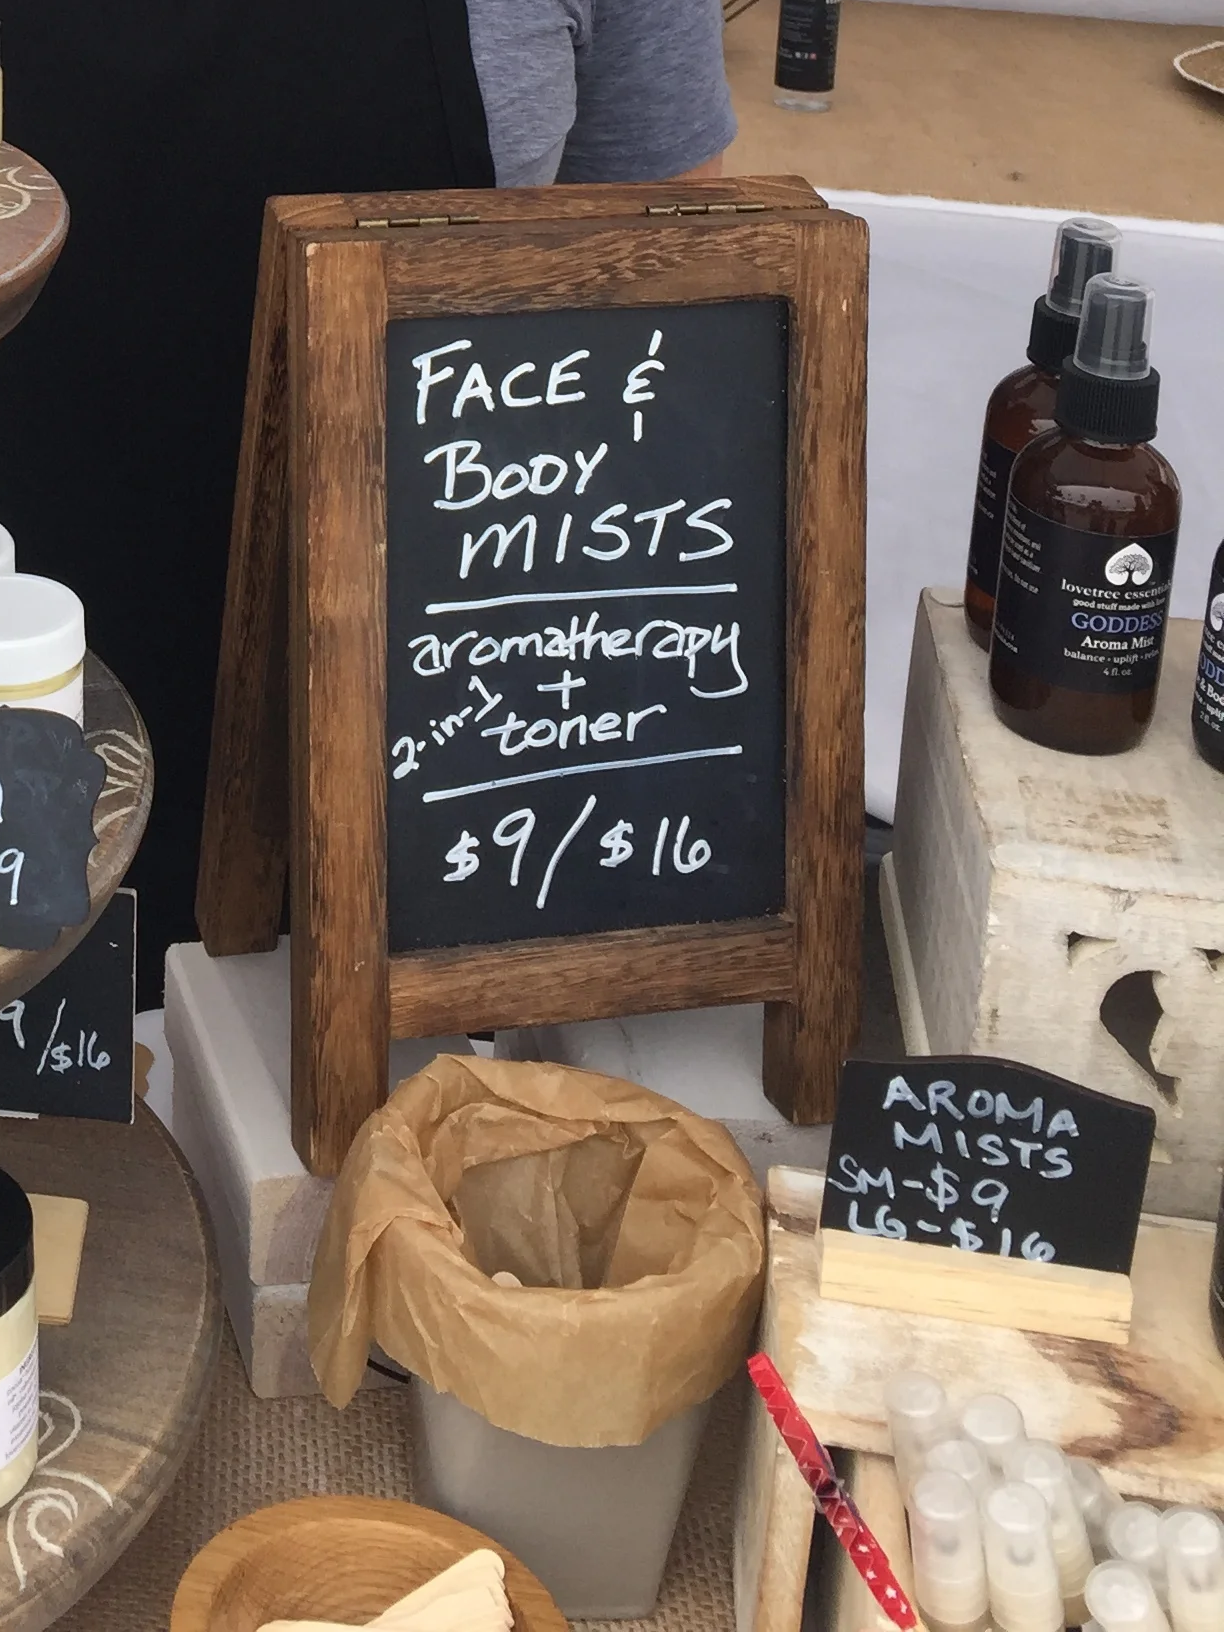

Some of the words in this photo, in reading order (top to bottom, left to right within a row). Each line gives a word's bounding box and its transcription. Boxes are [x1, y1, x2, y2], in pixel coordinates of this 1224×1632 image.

[412, 339, 590, 424] FACE
[460, 499, 733, 578] MISTS
[1061, 578, 1121, 600] lovetree
[1071, 610, 1164, 634] GODDESS
[1081, 635, 1128, 650] Aroma
[1131, 636, 1154, 650] Mist
[408, 612, 748, 698] aromatherapy
[1064, 648, 1106, 663] balance
[481, 704, 666, 756] toner
[883, 1074, 1080, 1138] AROMA
[893, 1122, 1074, 1179] MISTS
